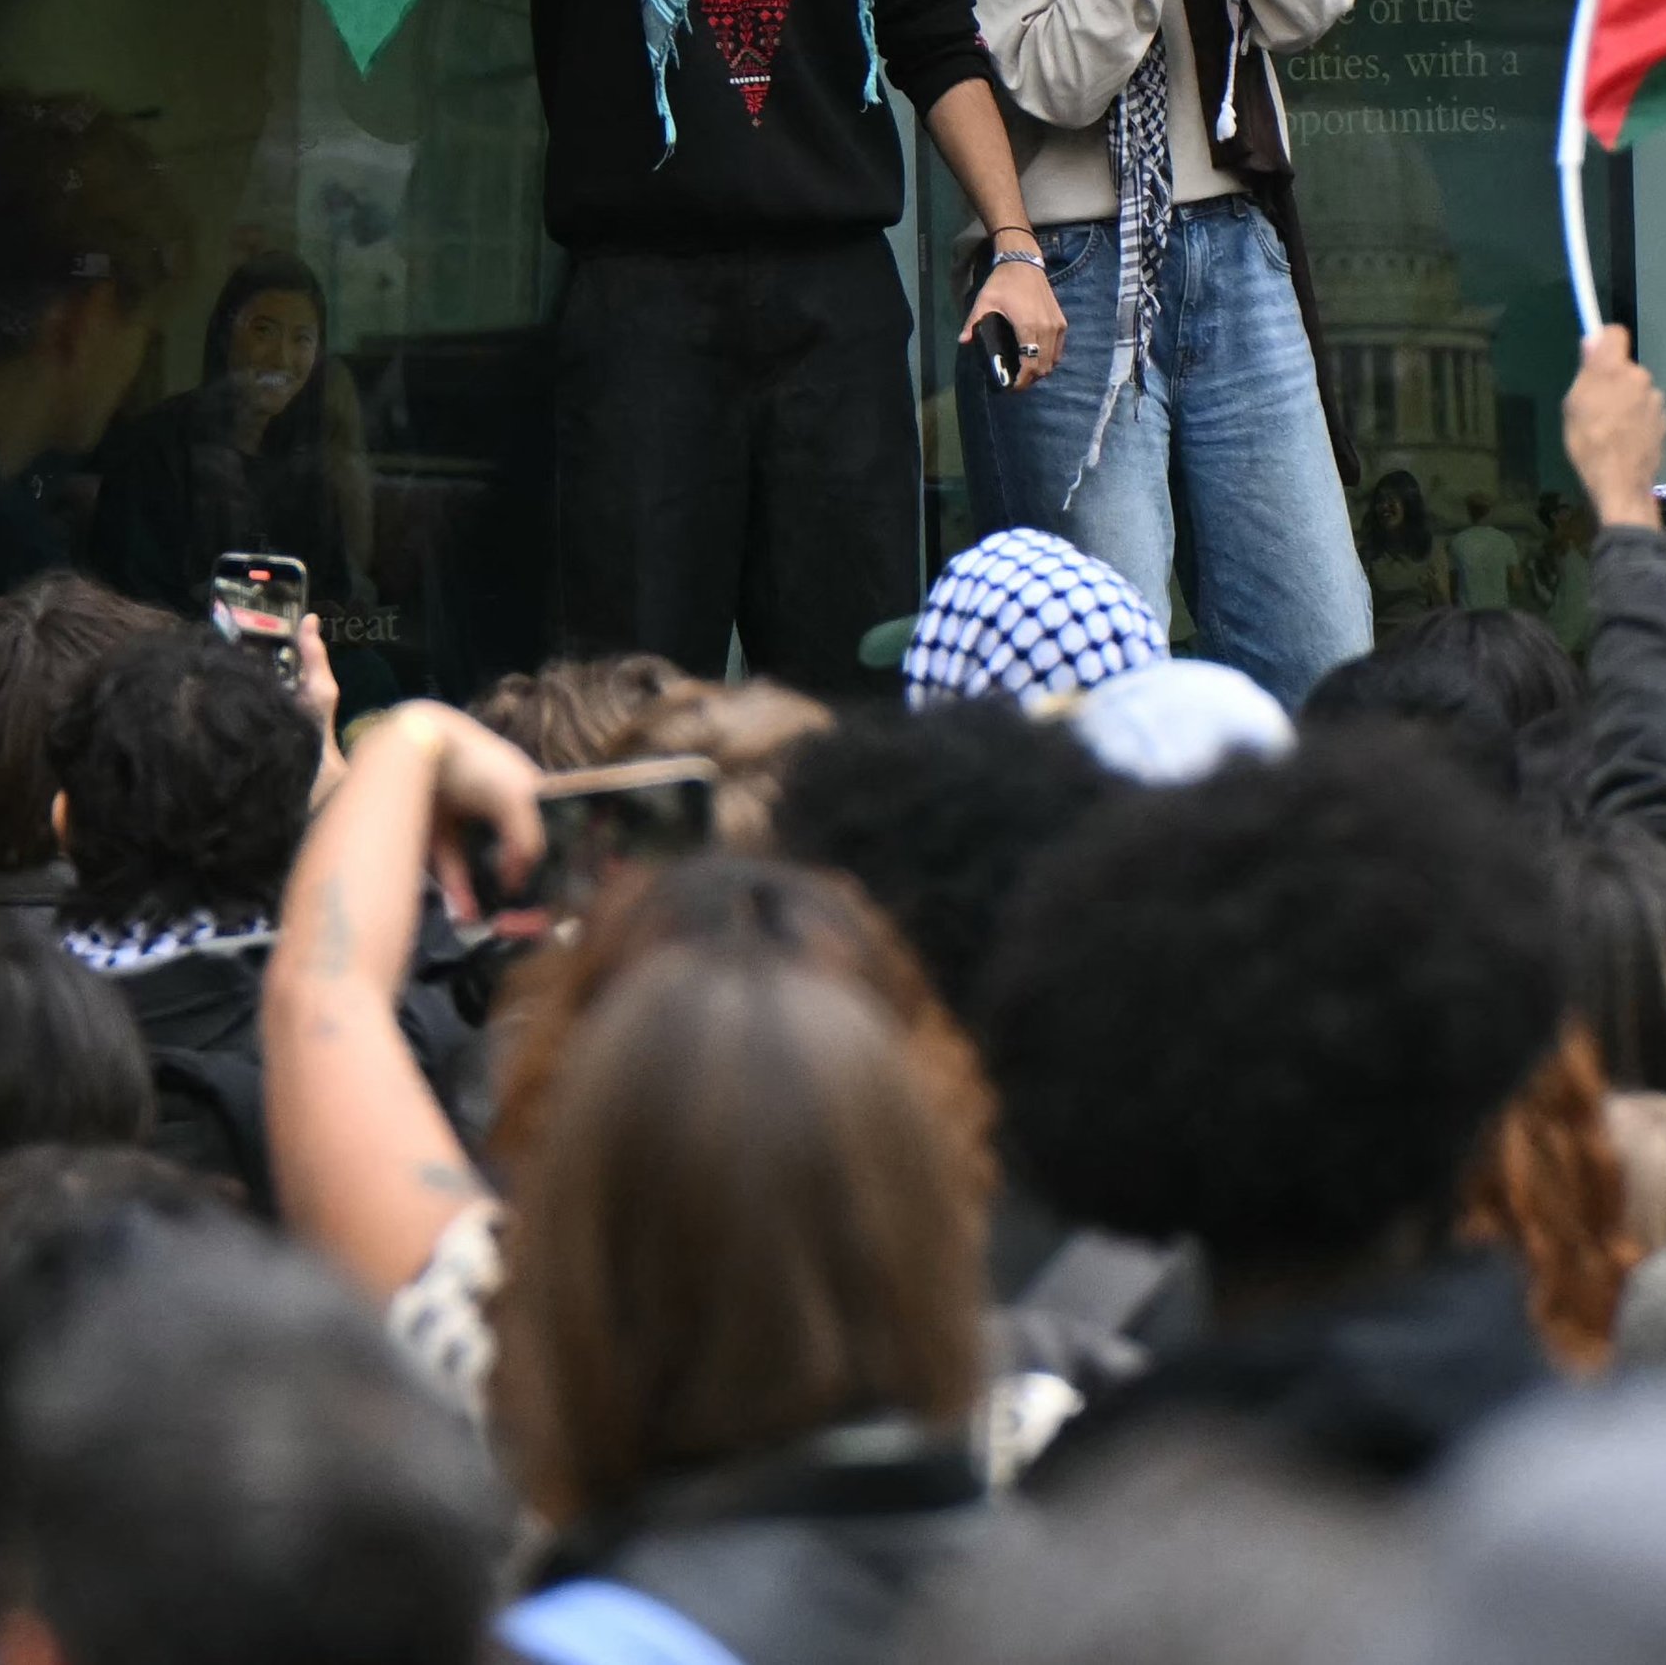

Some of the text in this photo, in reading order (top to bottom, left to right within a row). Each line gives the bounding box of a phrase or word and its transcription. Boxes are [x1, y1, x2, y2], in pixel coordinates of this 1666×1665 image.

[1287, 39, 1522, 86] cities, with a
[323, 609, 402, 642] reat
